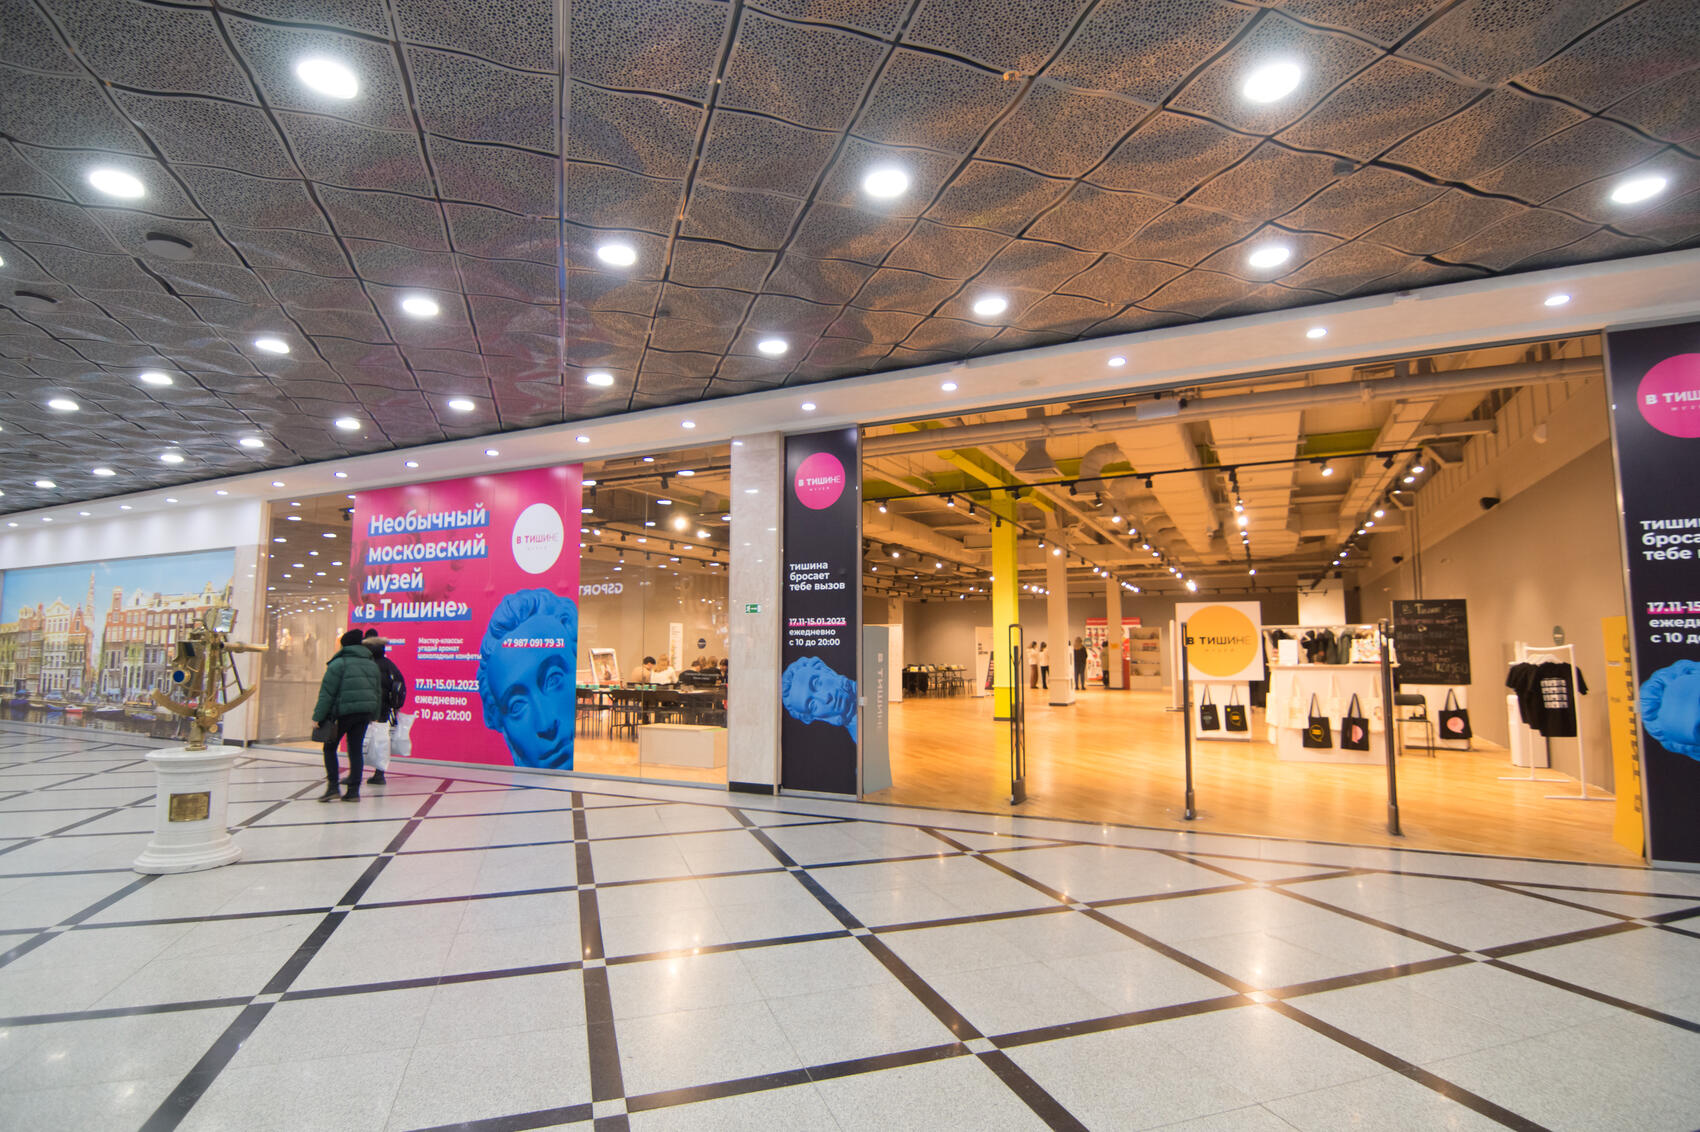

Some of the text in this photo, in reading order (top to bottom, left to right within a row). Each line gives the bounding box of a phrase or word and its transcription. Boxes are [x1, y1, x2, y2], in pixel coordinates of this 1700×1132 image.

[1645, 394, 1658, 405] В
[806, 475, 840, 486] ТИШИНЕ
[370, 502, 486, 534] Необычный
[368, 533, 486, 562] московский
[1642, 546, 1693, 561] тебе
[790, 561, 828, 571] тишина
[367, 567, 423, 595] музей
[790, 571, 830, 582] бросает
[790, 582, 846, 591] тебе вызов
[354, 598, 469, 619] «в Тишине»
[789, 617, 846, 626] 17.11-15.01.2023
[503, 638, 565, 647] +7 987 091 79 31
[795, 638, 804, 646] 10
[805, 639, 816, 647] до
[817, 638, 840, 646] 20:00
[1200, 635, 1252, 646] ТИШИНЕ
[1650, 634, 1662, 643] с
[1664, 632, 1683, 643] 10
[415, 678, 480, 691] 17.11-15.01.2023
[414, 695, 468, 706] ежедневно
[421, 708, 431, 719] 10
[432, 711, 445, 721] до
[446, 710, 472, 721] 20:00
